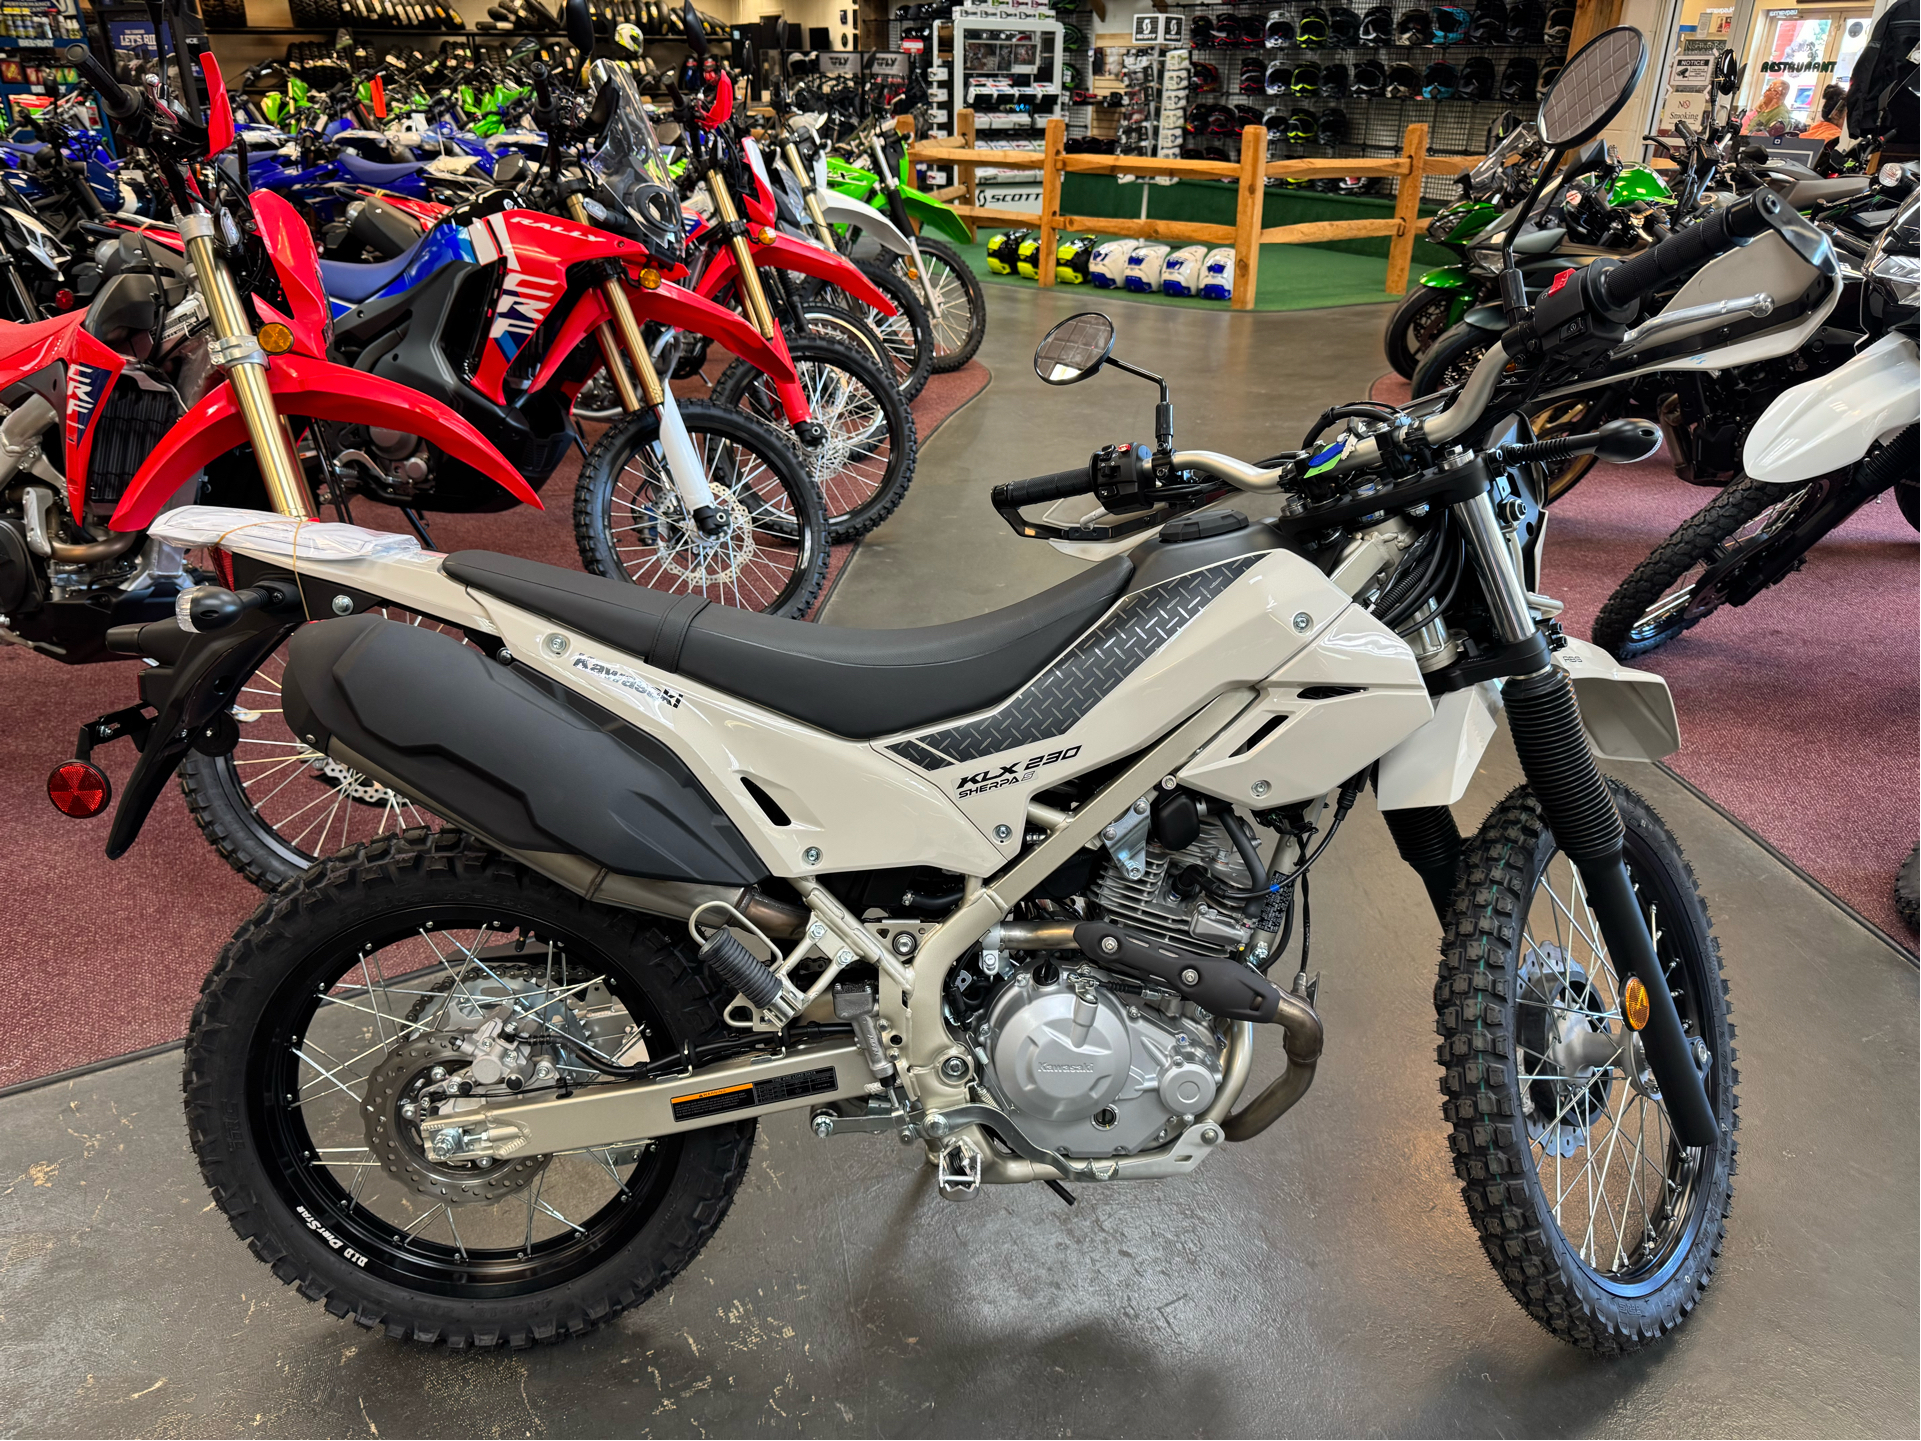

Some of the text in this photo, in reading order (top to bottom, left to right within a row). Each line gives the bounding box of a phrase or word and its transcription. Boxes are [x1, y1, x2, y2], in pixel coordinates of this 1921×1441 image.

[1669, 111, 1699, 122] Smoking
[989, 192, 1044, 204] SCOTT
[509, 216, 608, 242] RALLY
[489, 272, 560, 339] CRF
[66, 363, 96, 415] CRF
[956, 745, 1083, 790] KLX 230
[958, 776, 1020, 799] SHERPA
[1037, 1061, 1095, 1073] Kawasaki
